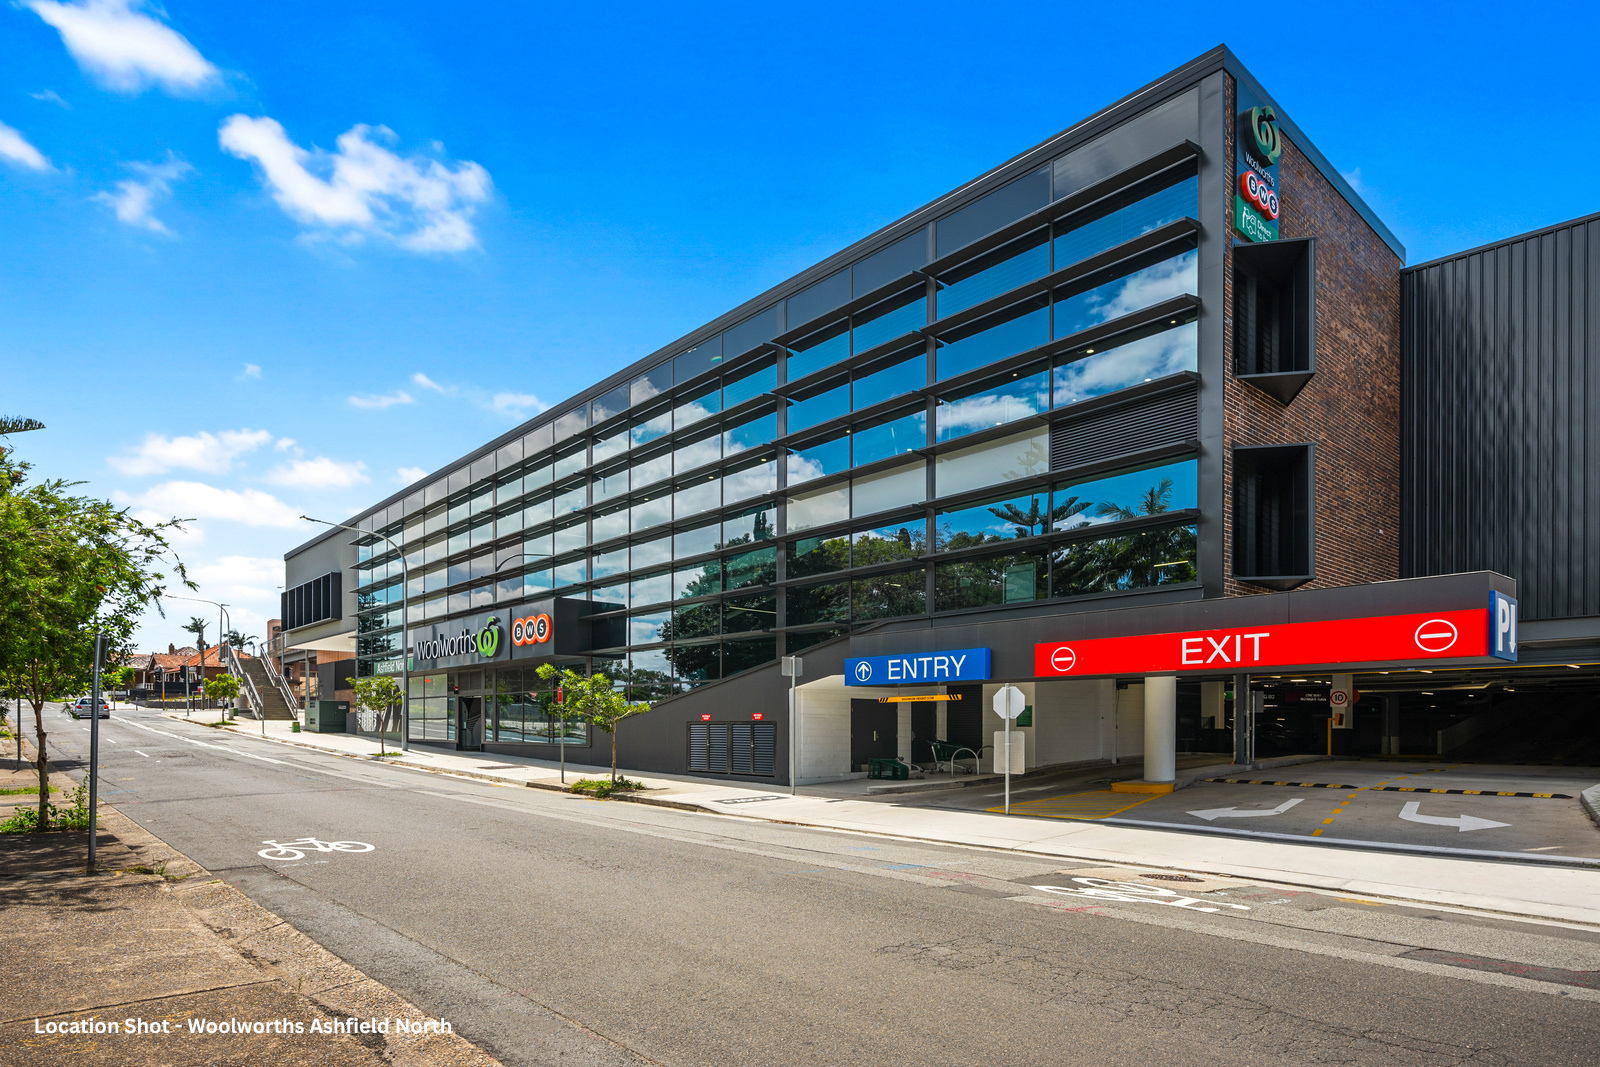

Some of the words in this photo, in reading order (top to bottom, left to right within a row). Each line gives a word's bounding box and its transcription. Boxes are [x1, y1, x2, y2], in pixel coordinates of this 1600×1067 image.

[1245, 151, 1275, 187] Woolworths
[1248, 177, 1277, 213] BWS
[1257, 219, 1272, 239] Direct
[1498, 597, 1510, 652] P
[1182, 632, 1270, 665] EXIT
[888, 654, 967, 680] ENTRY
[1334, 694, 1344, 702] 10
